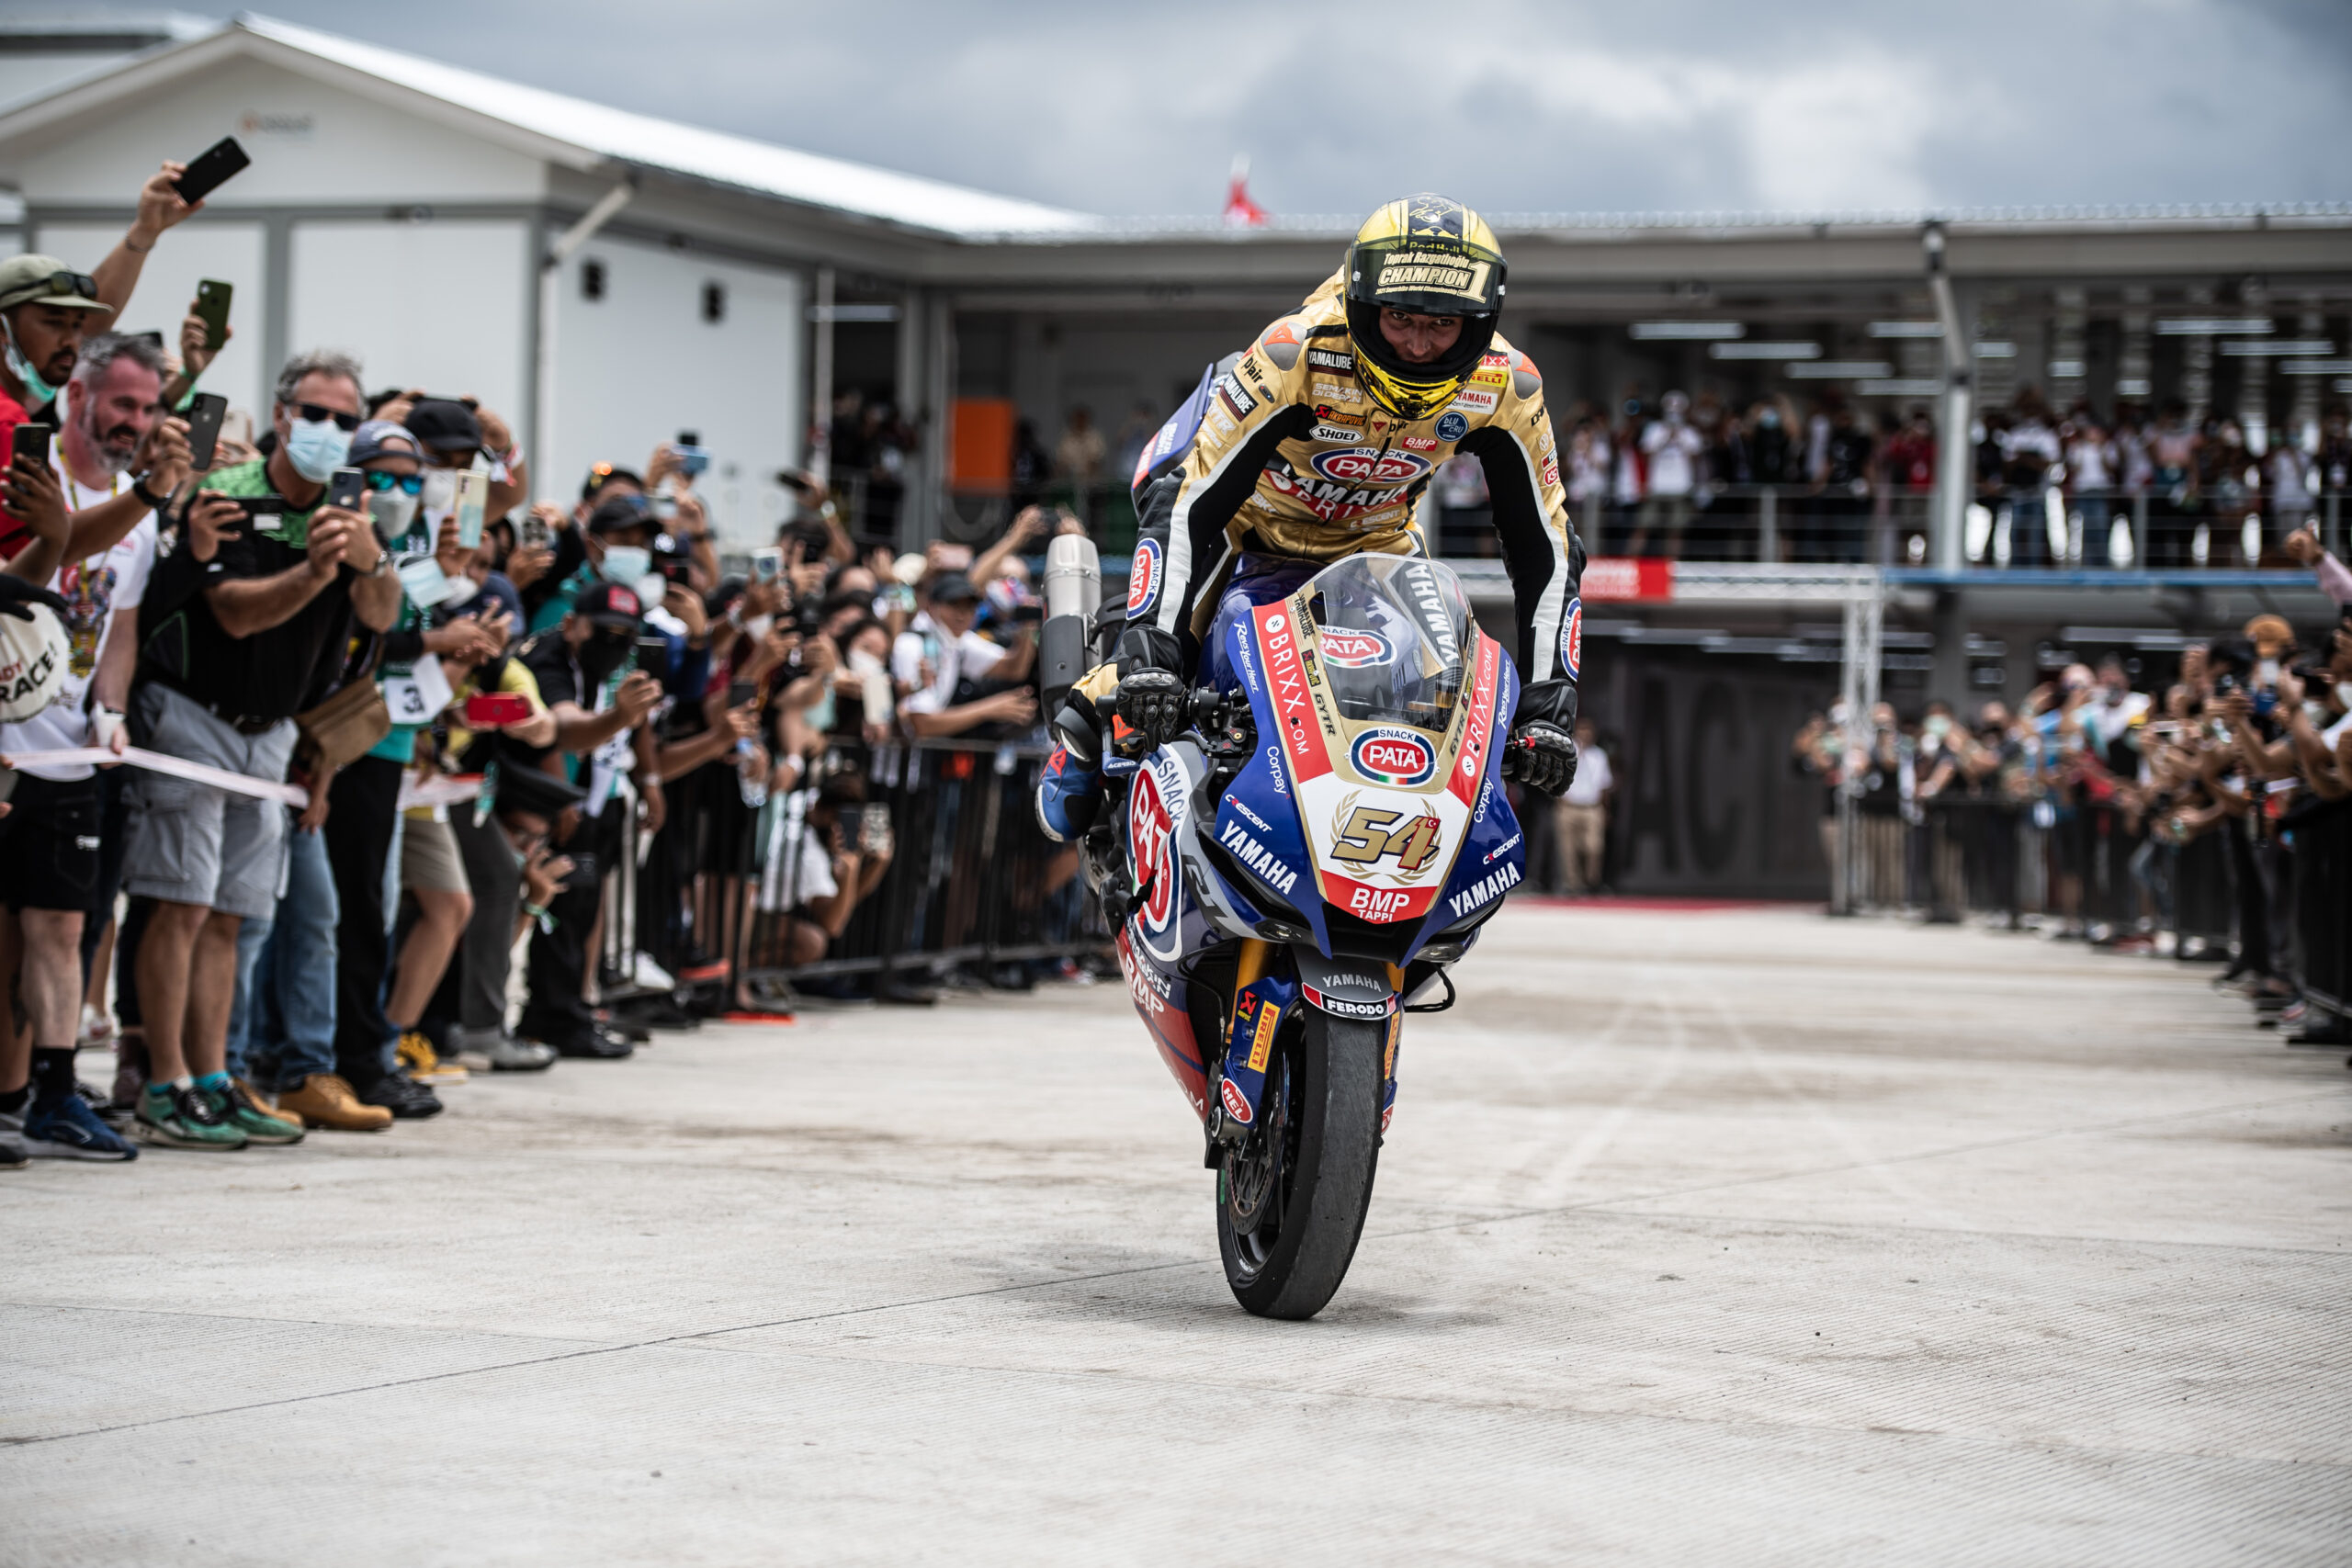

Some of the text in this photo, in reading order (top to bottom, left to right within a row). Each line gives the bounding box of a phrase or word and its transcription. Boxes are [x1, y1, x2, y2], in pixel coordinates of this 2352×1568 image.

[1378, 266, 1470, 288] CHAMPION
[1457, 261, 1491, 303] 1
[1308, 351, 1352, 369] YAMALUBE
[1483, 355, 1508, 366] IXX
[1471, 375, 1501, 384] RELLI
[1457, 391, 1492, 405] YAMAHA
[1317, 428, 1356, 441] SHOEI
[1406, 437, 1436, 447] BMP
[1335, 458, 1403, 479] PATA
[1129, 553, 1148, 602] PATA
[1149, 559, 1160, 593] SNACK
[1405, 564, 1459, 662] YAMAHA
[1562, 616, 1572, 650] SNACK
[1314, 693, 1337, 737] GYTR
[1379, 729, 1416, 741] SNACK
[1267, 746, 1286, 794] Corpay
[1369, 745, 1419, 769] PATA
[1158, 761, 1185, 826] SNACK
[1474, 777, 1494, 823] Corpay
[1225, 794, 1272, 832] CRESCENT
[1134, 783, 1169, 909] PATA
[1329, 807, 1441, 871] 54
[1482, 833, 1521, 865] CRESCENT
[1219, 819, 1298, 896] YAMAHA
[1350, 887, 1410, 913] BMP
[1448, 861, 1521, 918] YAMAHA
[1358, 909, 1394, 922] TAPPI
[1323, 974, 1382, 992] YAMAHA
[1327, 998, 1385, 1015] FERODO
[1251, 1006, 1276, 1066] PIRELLI
[1223, 1087, 1243, 1120] HEL
